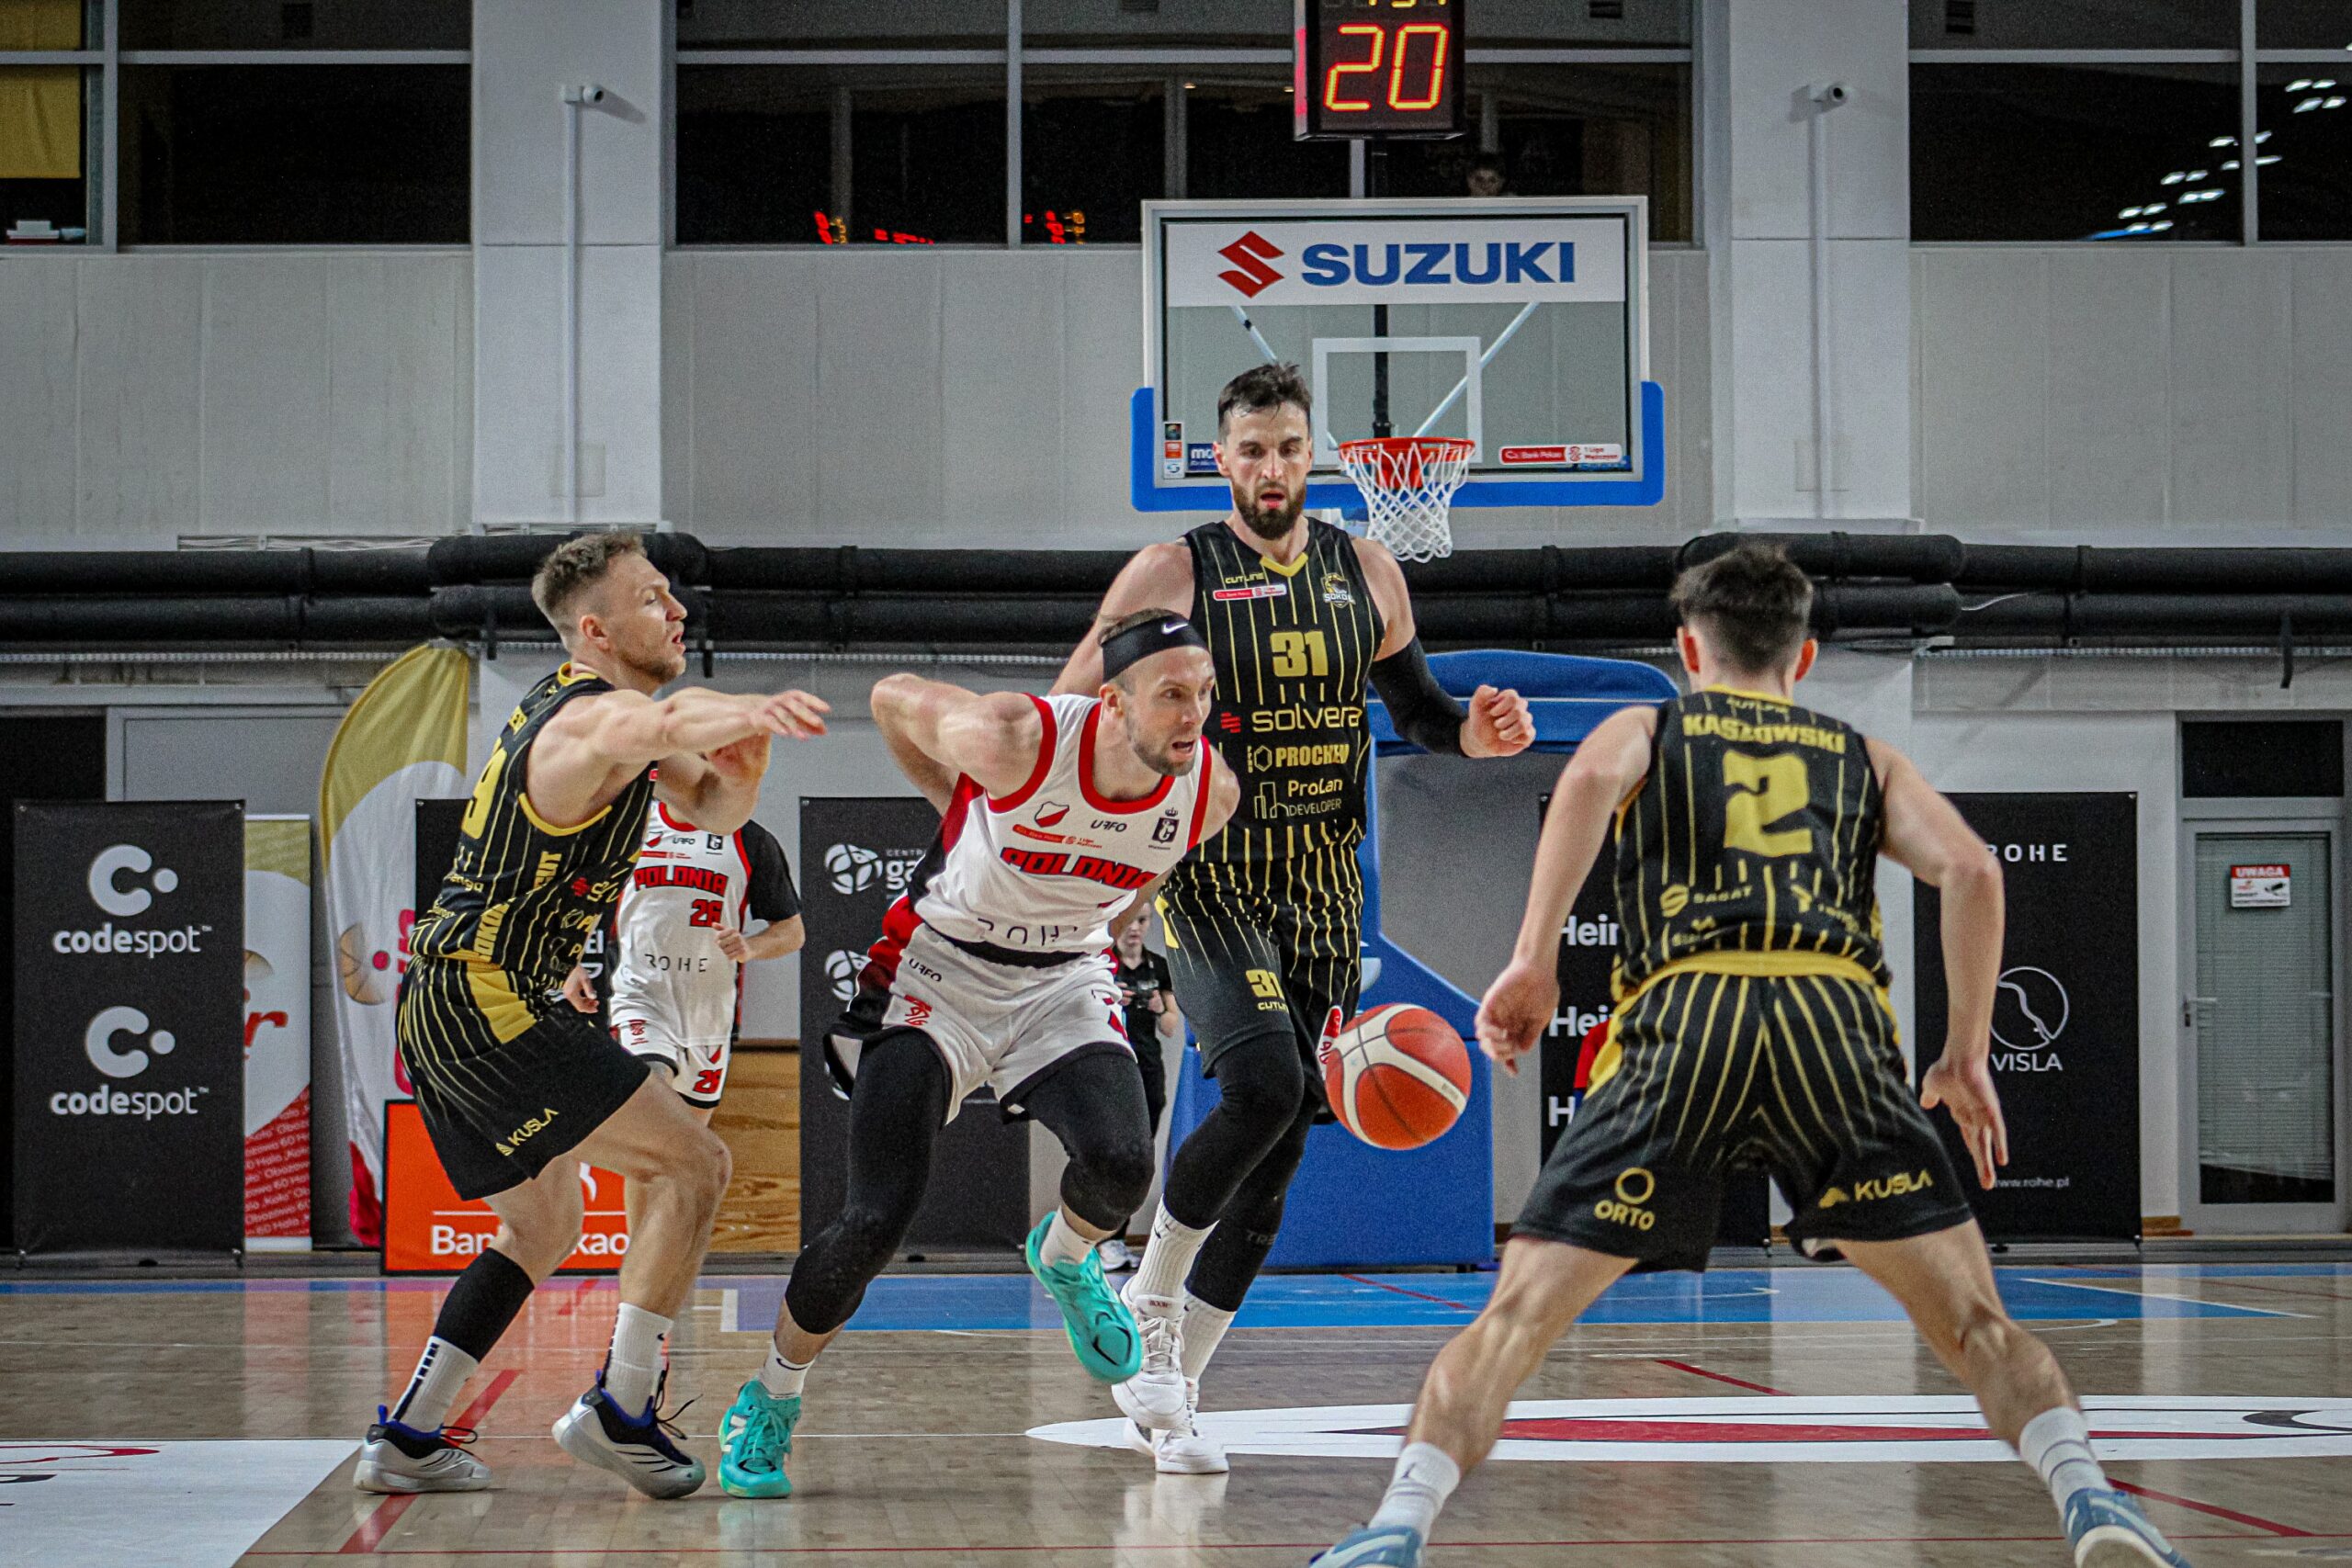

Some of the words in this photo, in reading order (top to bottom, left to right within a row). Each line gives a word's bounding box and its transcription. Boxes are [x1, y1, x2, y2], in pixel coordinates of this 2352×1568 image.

[1323, 22, 1450, 111] 20
[1301, 242, 1576, 286] SUZUKI
[1270, 630, 1329, 677] 31
[1289, 798, 1342, 817] DEVELOPER
[1722, 749, 1813, 858] 2
[635, 865, 729, 897] POLONIA
[690, 899, 723, 927] 26
[1991, 1053, 2063, 1072] VISLA
[508, 1108, 559, 1145] KUSLA
[1854, 1168, 1933, 1202] KUSLA
[1594, 1200, 1655, 1231] ORTO
[432, 1225, 504, 1255] Ban
[571, 1232, 630, 1256] kao
